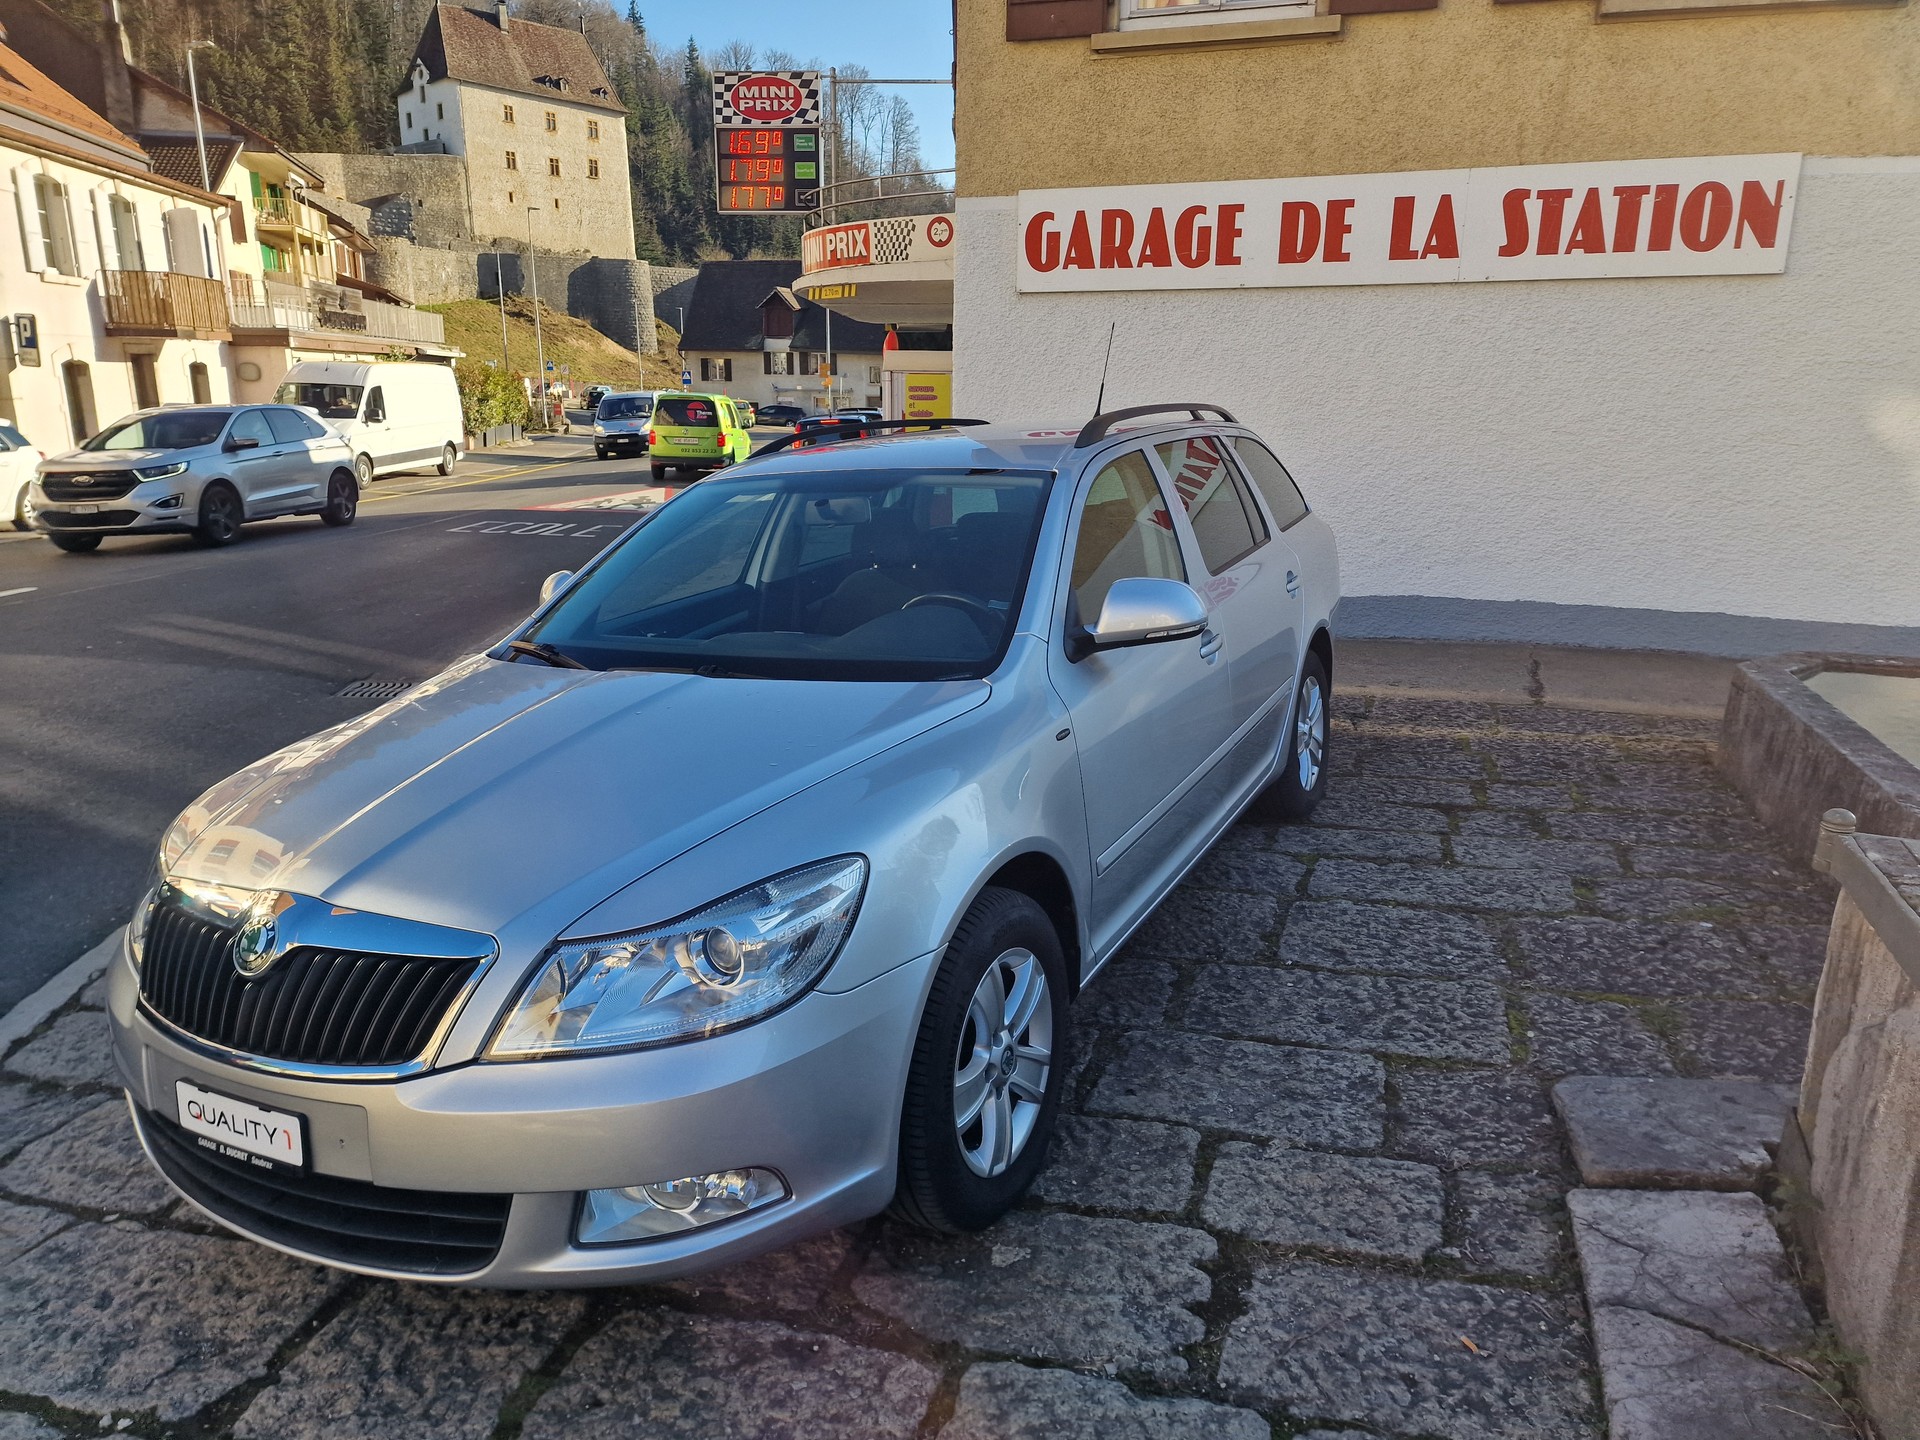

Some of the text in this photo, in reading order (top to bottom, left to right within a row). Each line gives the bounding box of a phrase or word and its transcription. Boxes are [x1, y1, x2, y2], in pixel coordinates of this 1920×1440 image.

[738, 86, 795, 98] MINI
[739, 99, 796, 111] PRIX
[1025, 180, 1786, 273] GARAGE DE LA STATION
[826, 228, 868, 261] PRIX
[19, 318, 31, 346] P
[445, 520, 623, 537] ECOLE
[187, 1100, 292, 1150] QUALITY 1
[198, 1137, 217, 1151] GARAGE
